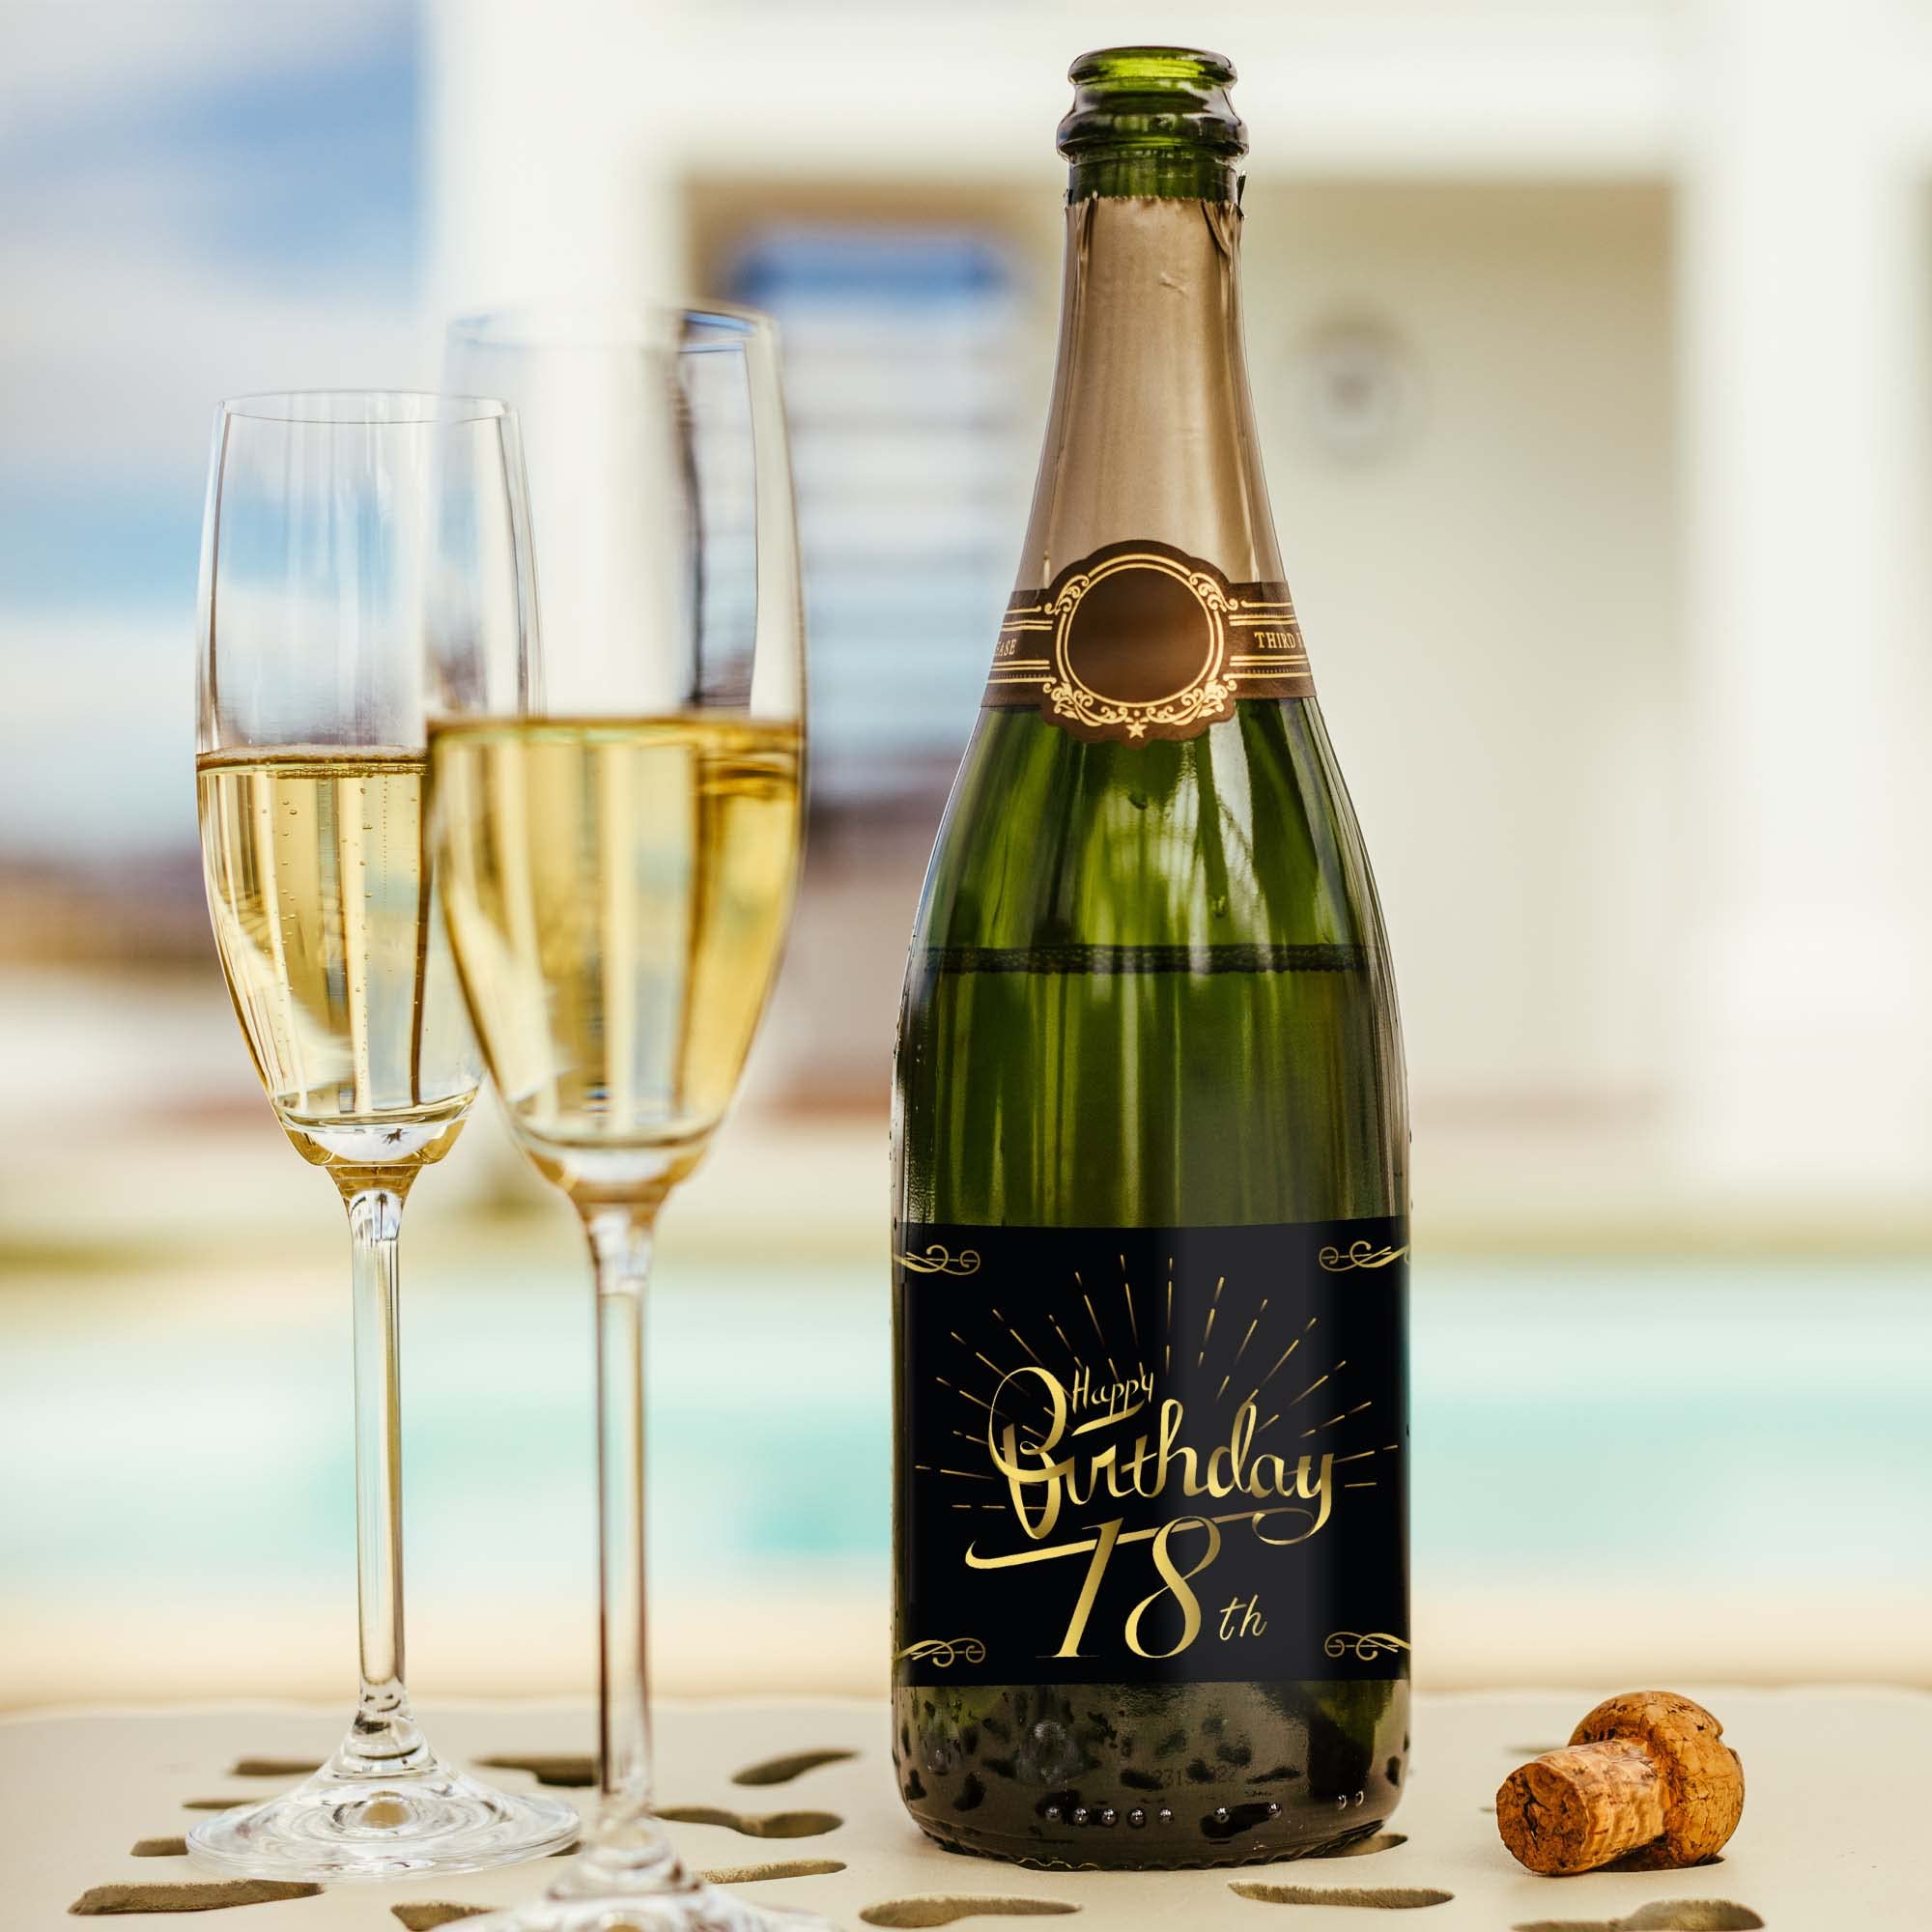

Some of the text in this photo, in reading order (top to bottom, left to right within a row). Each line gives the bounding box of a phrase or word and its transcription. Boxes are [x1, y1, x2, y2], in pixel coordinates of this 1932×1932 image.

[1254, 631, 1296, 648] THIRD
[1071, 1366, 1153, 1418] Happy
[988, 1367, 1334, 1545] Birthday
